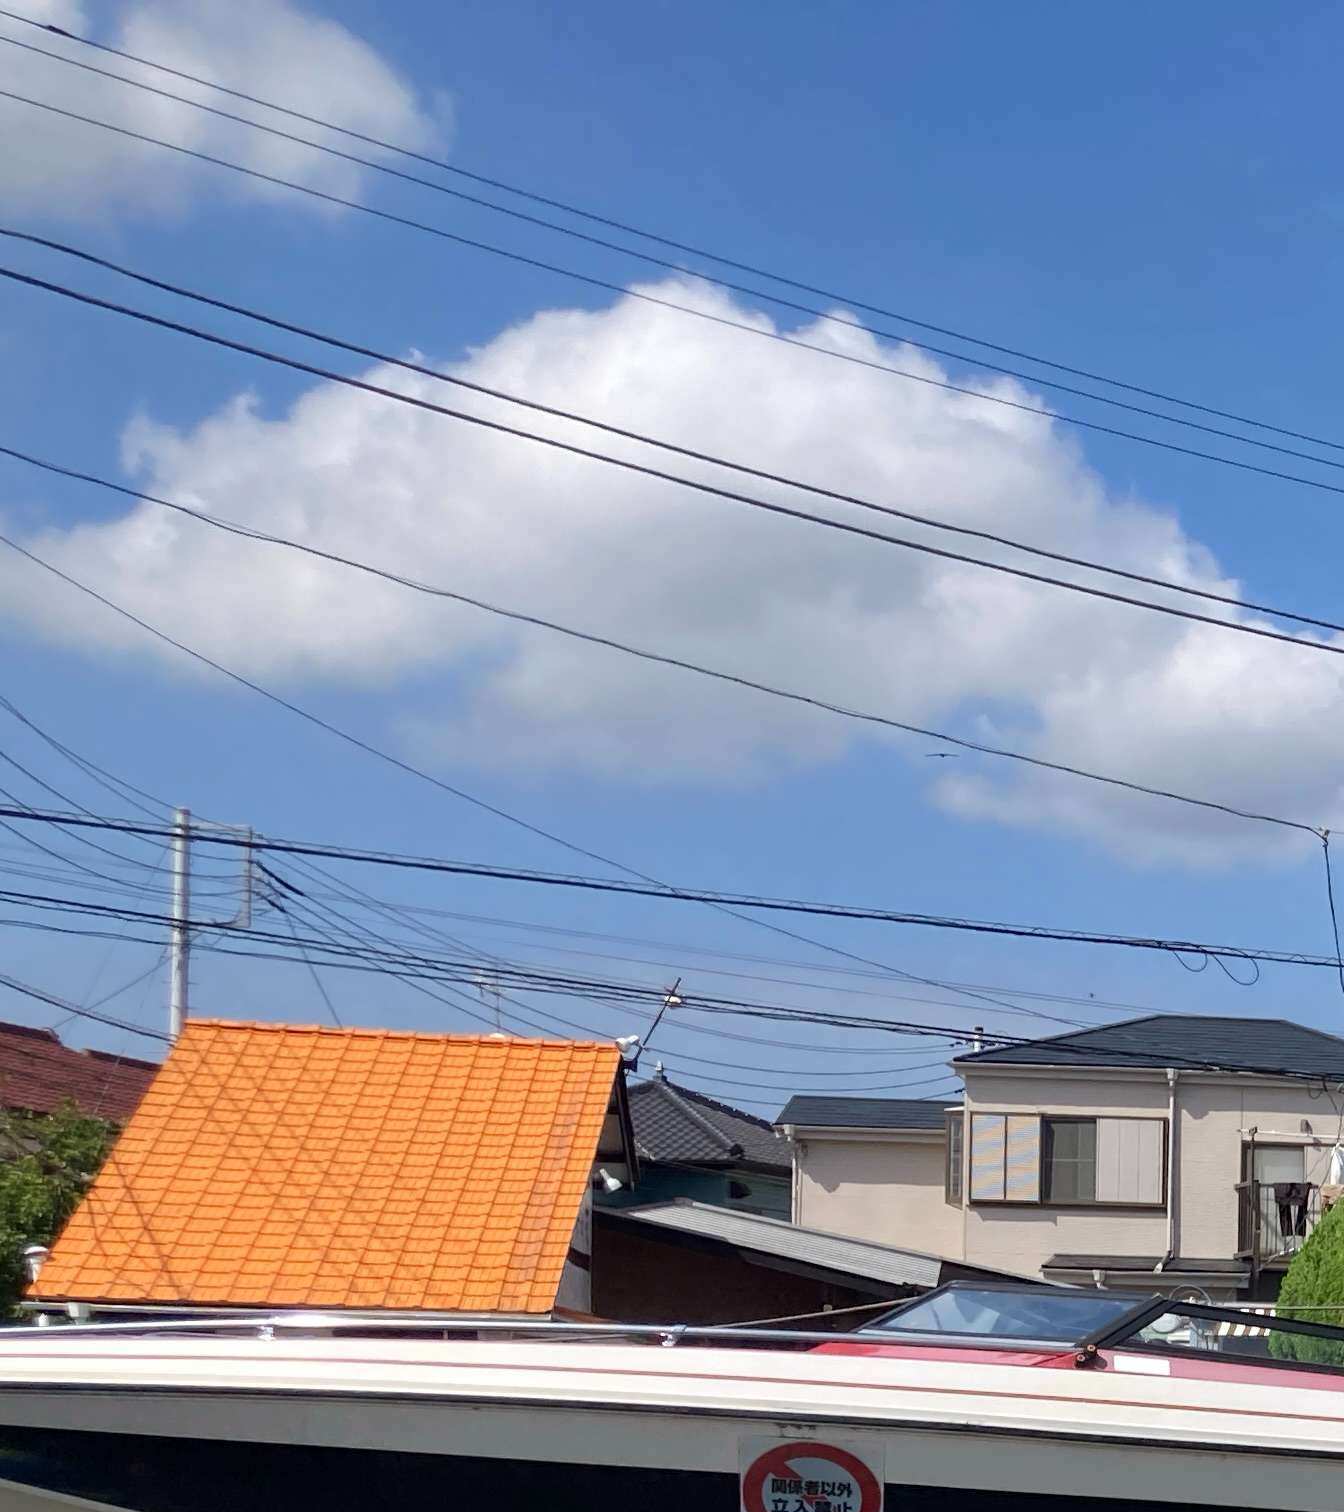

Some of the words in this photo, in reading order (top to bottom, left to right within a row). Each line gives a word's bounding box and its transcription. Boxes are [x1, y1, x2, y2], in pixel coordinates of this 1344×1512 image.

[771, 1478, 853, 1498] 関係者以外
